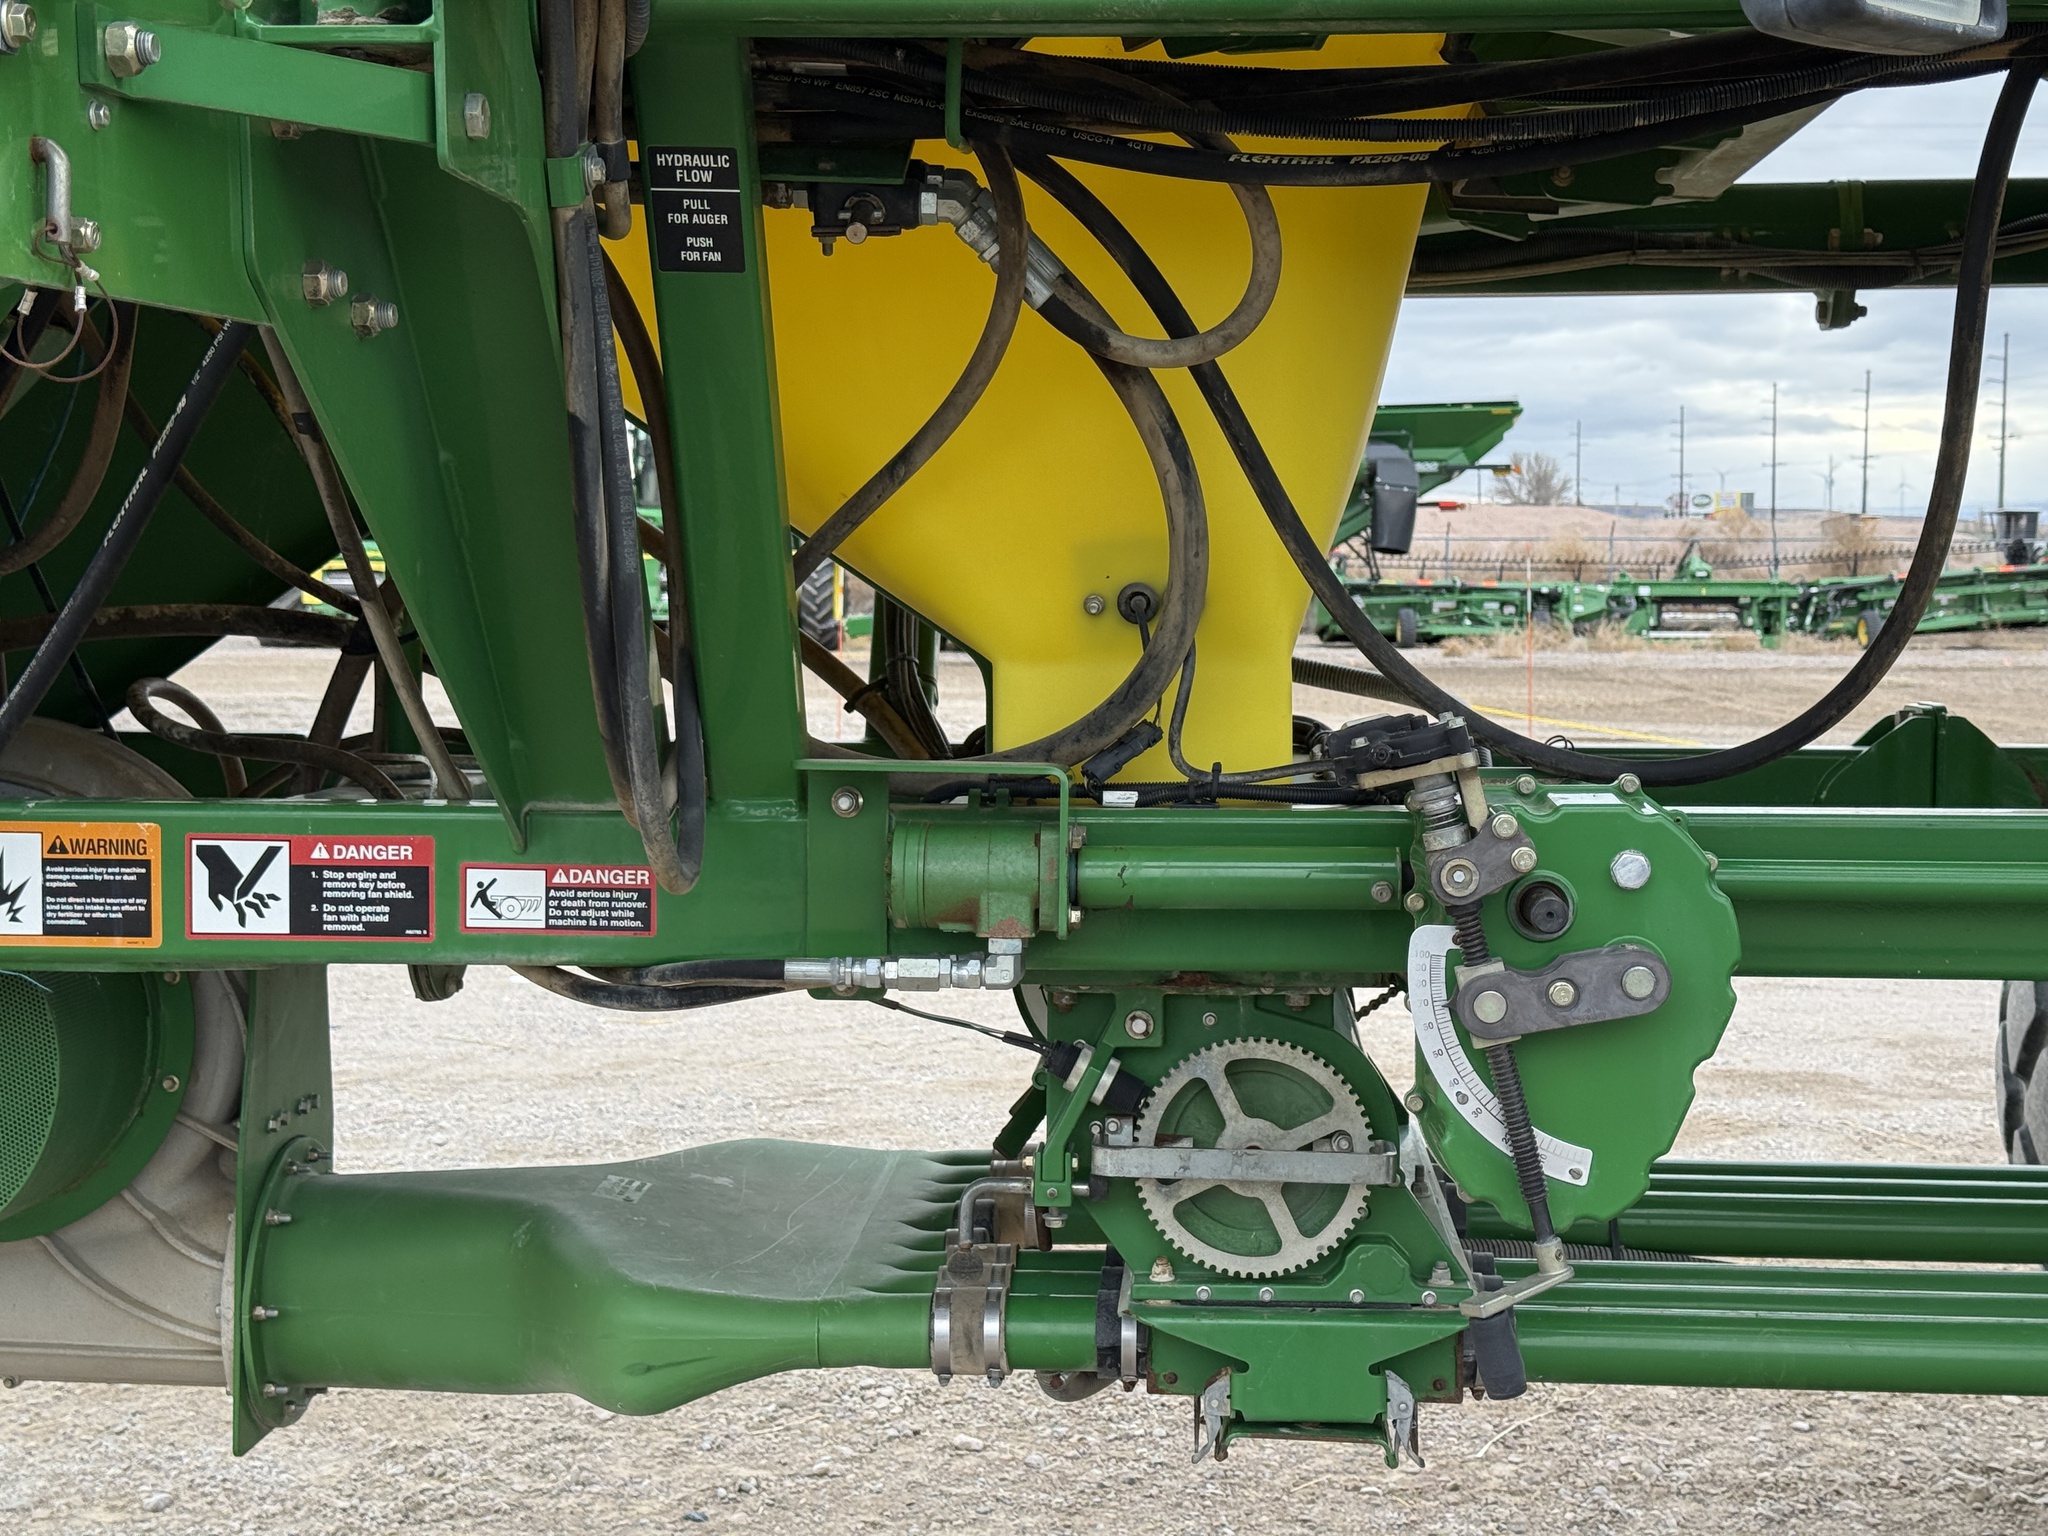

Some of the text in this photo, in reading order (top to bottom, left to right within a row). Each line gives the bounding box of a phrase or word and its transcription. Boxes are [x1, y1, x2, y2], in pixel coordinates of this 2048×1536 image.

[814, 78, 830, 87] WP
[835, 83, 867, 94] EN857
[869, 88, 890, 99] 2SC
[894, 93, 924, 106] MSHA
[965, 108, 1154, 152] Exceeds SAE100R16 USCG-H 4Q19
[1228, 153, 1335, 165] FLEXTRAL
[1349, 152, 1430, 165] PX250-08
[1471, 146, 1495, 155] 4250
[1519, 140, 1535, 149] WP
[657, 154, 730, 168] HYDRAULIC
[676, 170, 712, 183] FLOW
[683, 199, 710, 210] PULL
[668, 213, 728, 225] FOR AUGER
[687, 237, 713, 247] PUSH
[681, 251, 722, 262] FOR FAN
[69, 838, 147, 856] WARNING
[333, 845, 413, 860] DANGER
[323, 870, 344, 880] Stop
[346, 871, 377, 880] engine
[379, 871, 396, 879] and
[569, 869, 649, 885] DANGER
[359, 880, 374, 890] key
[377, 881, 406, 889] before
[323, 890, 414, 899] removing fan shield.
[549, 889, 638, 900] Avoid serious injury
[323, 904, 336, 912] Do
[355, 904, 390, 914] operate
[581, 909, 609, 919] adjust
[323, 913, 388, 922] fan with shield
[549, 918, 587, 926] machine
[610, 919, 644, 928] motion.
[323, 923, 365, 931] removed.
[1432, 1048, 1443, 1058] 50
[1448, 1078, 1460, 1088] 40
[1472, 1107, 1483, 1118] 30
[1502, 1133, 1510, 1144] 2
